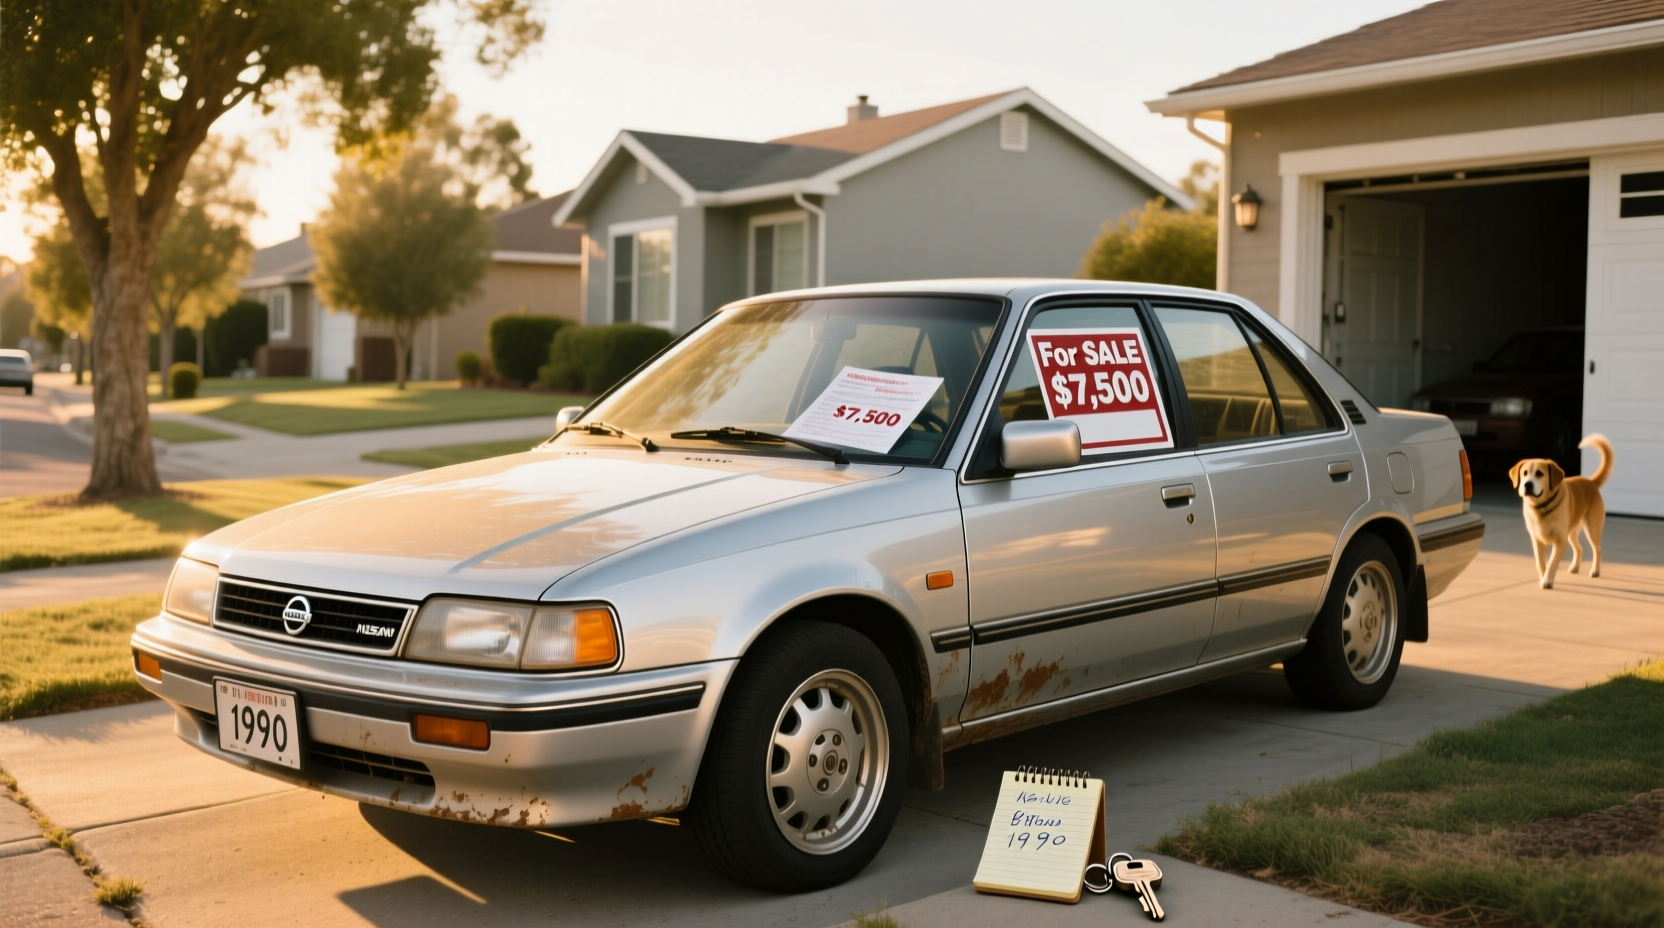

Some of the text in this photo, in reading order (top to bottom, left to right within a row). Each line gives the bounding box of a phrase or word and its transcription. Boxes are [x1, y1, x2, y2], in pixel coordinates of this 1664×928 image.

[1037, 340, 1142, 367] For SALE
[1051, 370, 1150, 410] $7,500
[833, 405, 901, 427] $7,500
[231, 703, 288, 753] 1990
[1007, 832, 1066, 851] 1990
